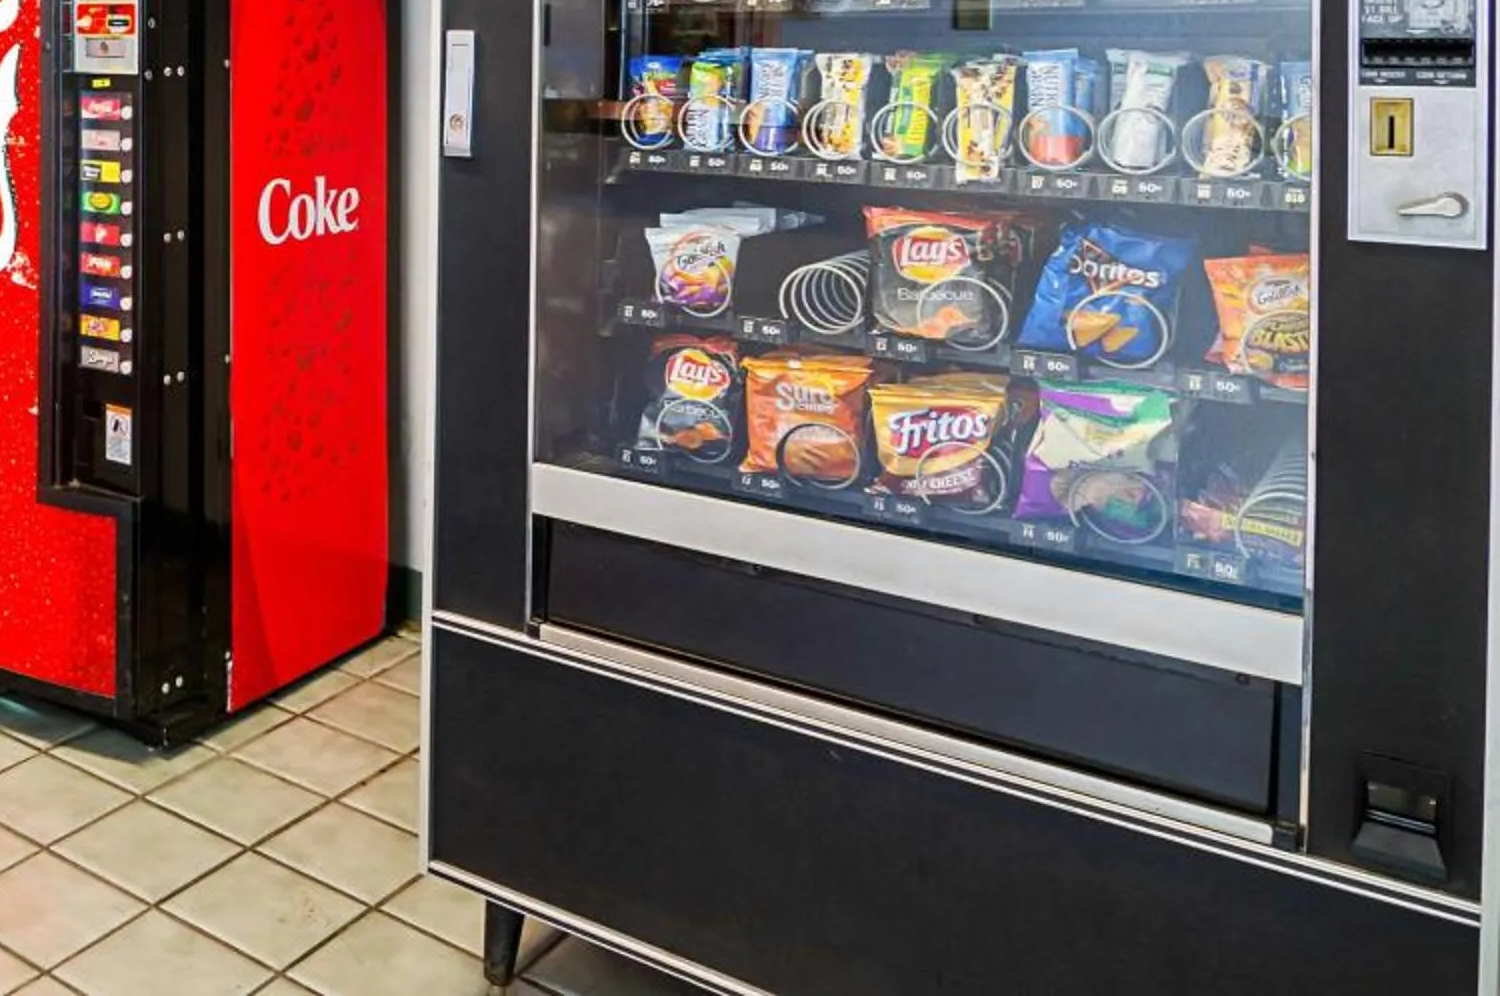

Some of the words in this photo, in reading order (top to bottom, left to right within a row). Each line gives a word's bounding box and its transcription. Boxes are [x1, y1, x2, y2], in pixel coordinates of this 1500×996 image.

[257, 175, 360, 246] Coke
[1069, 254, 1161, 289] Doritos
[888, 408, 989, 456] Fritos
